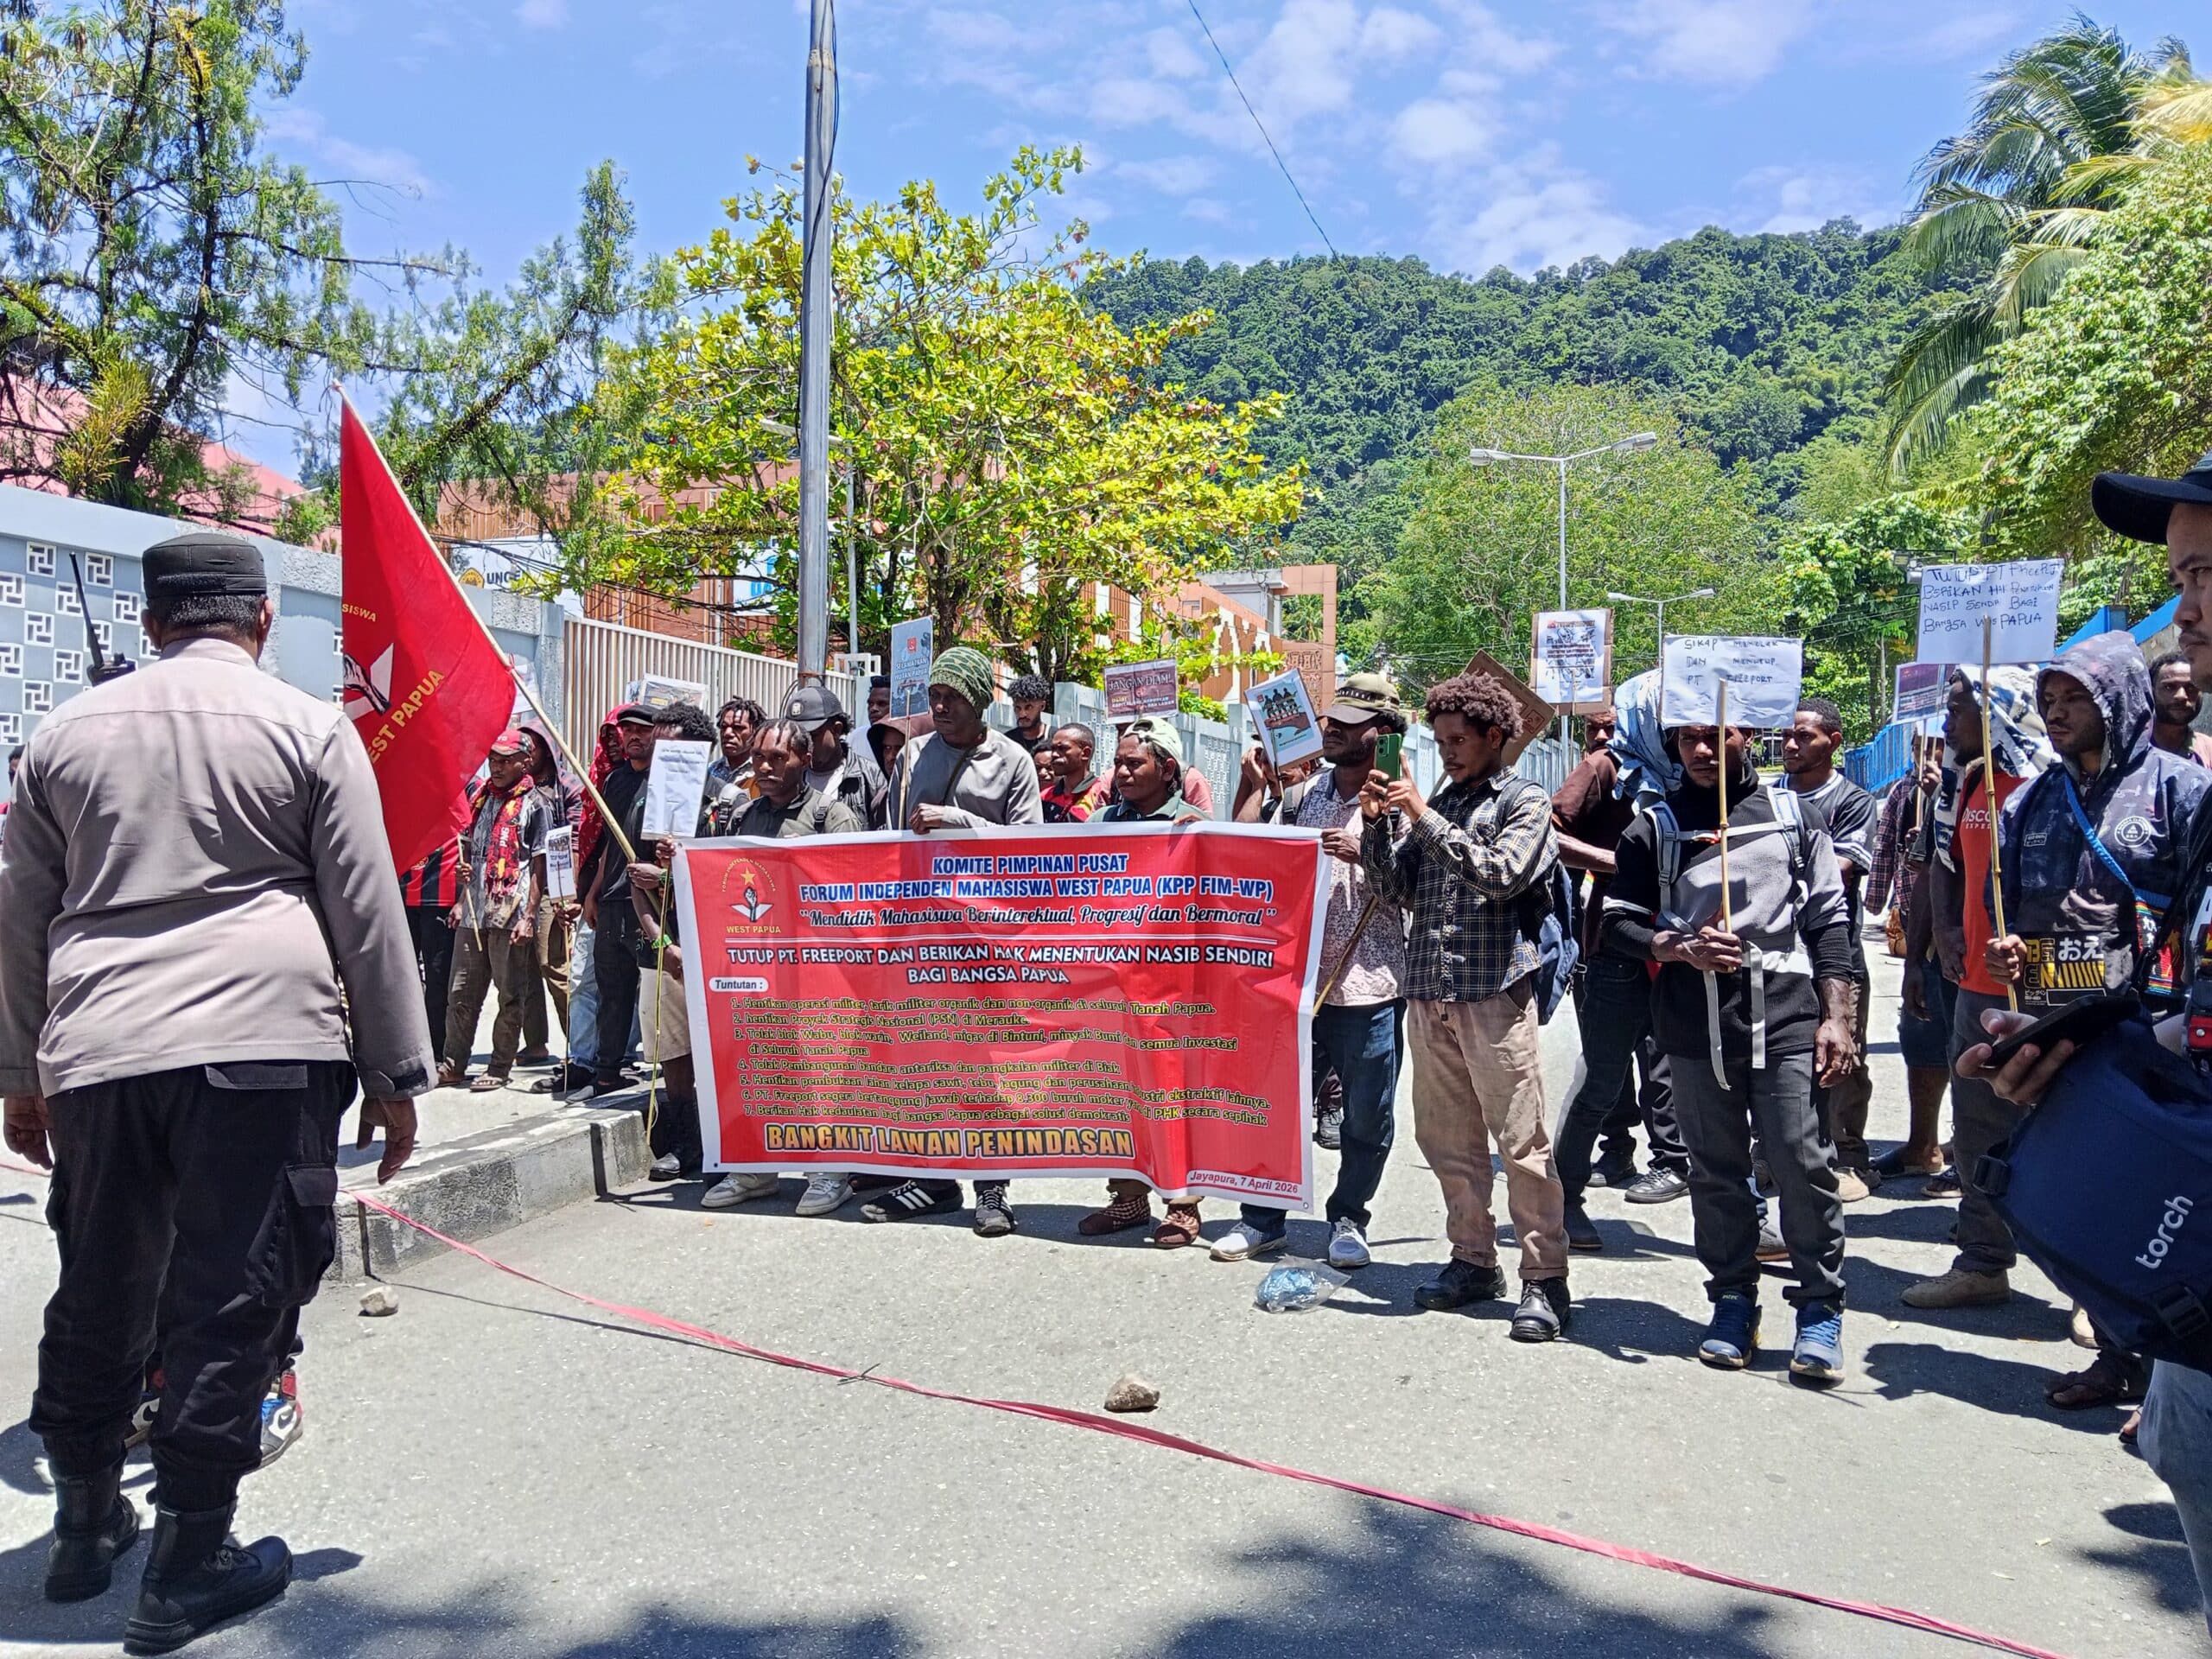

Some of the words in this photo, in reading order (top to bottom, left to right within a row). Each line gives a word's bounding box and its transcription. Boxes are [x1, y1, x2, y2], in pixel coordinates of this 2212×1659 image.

[342, 603, 378, 622] SISWA
[1686, 656, 1707, 668] DAN
[1109, 677, 1144, 691] JANGAN
[366, 724, 396, 763] EST
[391, 670, 445, 728] PAPUA
[500, 826, 510, 848] PNG
[933, 856, 992, 875] KOMITE
[998, 855, 1074, 874] PIMPINAN
[1078, 854, 1128, 873] PUSAT
[799, 884, 853, 902] FORUM
[859, 881, 952, 900] INDEPENDEN
[957, 878, 1052, 899] MAHASISWA
[1057, 878, 1101, 897] WEST
[1103, 878, 1151, 897] PAPUA
[1156, 876, 1194, 899] (KPP
[1200, 877, 1274, 902] FIM-WP)
[880, 907, 963, 926] Mahasiswa
[1080, 905, 1148, 929] Progresif
[1147, 906, 1181, 923] dan
[726, 925, 751, 934] WEST
[753, 925, 781, 934] PAPUA
[728, 949, 774, 964] TUTUP
[779, 949, 798, 963] PT.
[802, 949, 873, 964] FREEPORT
[877, 947, 913, 964] DAN
[919, 944, 989, 962] BERIKAN
[995, 947, 1026, 963] HAK
[1028, 944, 1141, 963] MENENTUKAN
[1147, 944, 1200, 963] NASIB
[1205, 946, 1274, 968] SENDIRI
[715, 979, 757, 990] Tuntutan
[907, 967, 947, 984] BAGI
[950, 965, 1016, 983] BANGSA
[1020, 966, 1071, 983] PAPUA
[743, 997, 790, 1009] Hentikan
[790, 997, 830, 1012] operasi
[869, 999, 893, 1011] tarik
[896, 997, 936, 1011] militer
[938, 996, 980, 1011] organik
[982, 996, 1005, 1009] dan
[1008, 998, 1075, 1014] non-organik
[1075, 999, 1088, 1012] di
[1090, 999, 1128, 1014] seluruh
[1130, 1001, 1171, 1015] Tanah
[1173, 1002, 1217, 1018] Papua.
[746, 1014, 790, 1025] hentikan
[791, 1014, 828, 1027] Proyek
[830, 1014, 874, 1027] Strategis
[877, 1014, 925, 1027] Nasional
[928, 1014, 960, 1027] (PSN)
[962, 1014, 972, 1025] di
[975, 1013, 1030, 1026] Merauke.
[747, 1028, 776, 1039] Tolak
[777, 1028, 799, 1039] blok
[839, 1028, 862, 1039] blok
[953, 1030, 984, 1044] migas
[986, 1030, 999, 1042] di
[1049, 1027, 1093, 1042] minyak
[1094, 1029, 1122, 1043] Bumi
[1139, 1039, 1181, 1051] semua
[1183, 1036, 1238, 1052] Investasi
[748, 1043, 760, 1054] di
[761, 1044, 799, 1055] Seluruh
[801, 1044, 836, 1055] Tanah
[837, 1045, 870, 1057] Papua
[750, 1058, 780, 1071] Tolak
[780, 1059, 856, 1073] Pembangunan
[858, 1061, 899, 1075] bandara
[899, 1060, 954, 1074] antariksa
[956, 1061, 976, 1073] dan
[978, 1061, 1039, 1077] pangkalan
[1041, 1059, 1080, 1072] militer
[1082, 1060, 1094, 1072] di
[753, 1074, 799, 1085] Hentikan
[800, 1074, 863, 1089] pembukaan
[865, 1076, 893, 1089] lahan
[893, 1078, 931, 1091] kelapa
[999, 1077, 1041, 1090] jagung
[1043, 1075, 1065, 1089] dan
[1068, 1077, 1132, 1092] perusahaan
[1167, 1086, 1225, 1102] ekstraktif
[754, 1090, 772, 1101] PT.
[773, 1090, 819, 1104] Freeport
[819, 1092, 855, 1103] segera
[856, 1090, 923, 1108] bertanggung
[924, 1092, 961, 1108] jawab
[962, 1092, 1014, 1106] terhadap
[1051, 1092, 1087, 1104] buruh
[1089, 1094, 1126, 1107] moker
[1154, 1105, 1181, 1121] PHK
[1182, 1107, 1221, 1119] secara
[756, 1104, 796, 1116] Berikan
[797, 1104, 821, 1116] Hak
[821, 1105, 879, 1118] kedaulatan
[880, 1108, 901, 1122] bagi
[904, 1109, 945, 1124] bangsa
[947, 1109, 982, 1124] Papua
[983, 1108, 1030, 1122] sebagai
[1032, 1108, 1065, 1120] solusi
[1068, 1107, 1131, 1123] demokratis
[765, 1122, 874, 1154] BANGKIT
[874, 1125, 963, 1158] LAWAN
[963, 1126, 1135, 1159] PENINDASAN
[1190, 1171, 1238, 1186] Jayapura,
[1241, 1177, 1246, 1186] 7
[1248, 1179, 1273, 1192] April
[1274, 1181, 1299, 1194] 2026
[2135, 1196, 2194, 1269] torch
